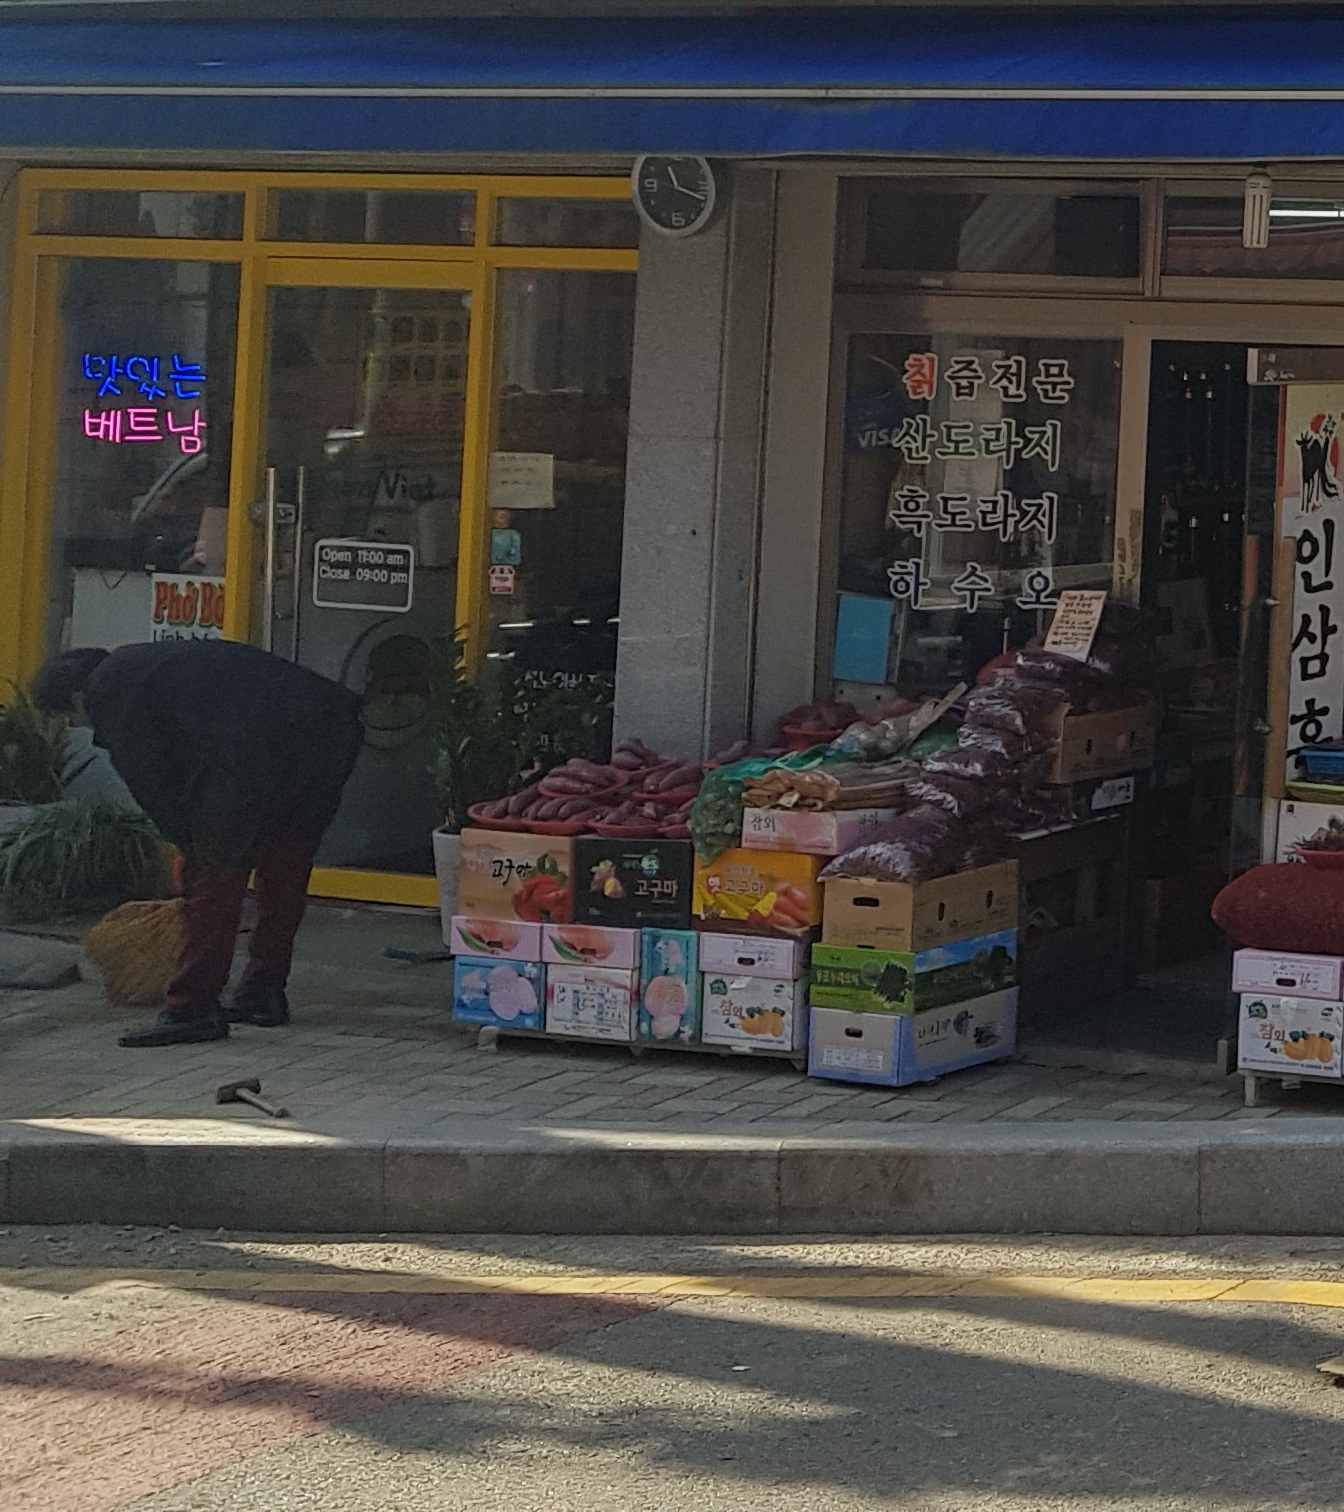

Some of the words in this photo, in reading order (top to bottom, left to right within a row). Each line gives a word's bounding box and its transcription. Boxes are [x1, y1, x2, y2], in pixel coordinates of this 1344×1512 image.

[83, 352, 206, 400] 맛있는
[902, 352, 1075, 405] 칡즙전문
[83, 407, 206, 454] 베트남
[898, 416, 1062, 472] 산도라지
[890, 488, 1059, 544] 흑도라지
[319, 565, 351, 580] Close
[356, 567, 388, 583] 09:00
[389, 572, 408, 585] pm
[322, 547, 352, 563] Open
[357, 550, 384, 564] 11:00
[386, 554, 404, 565] am
[634, 879, 679, 898] 고구마
